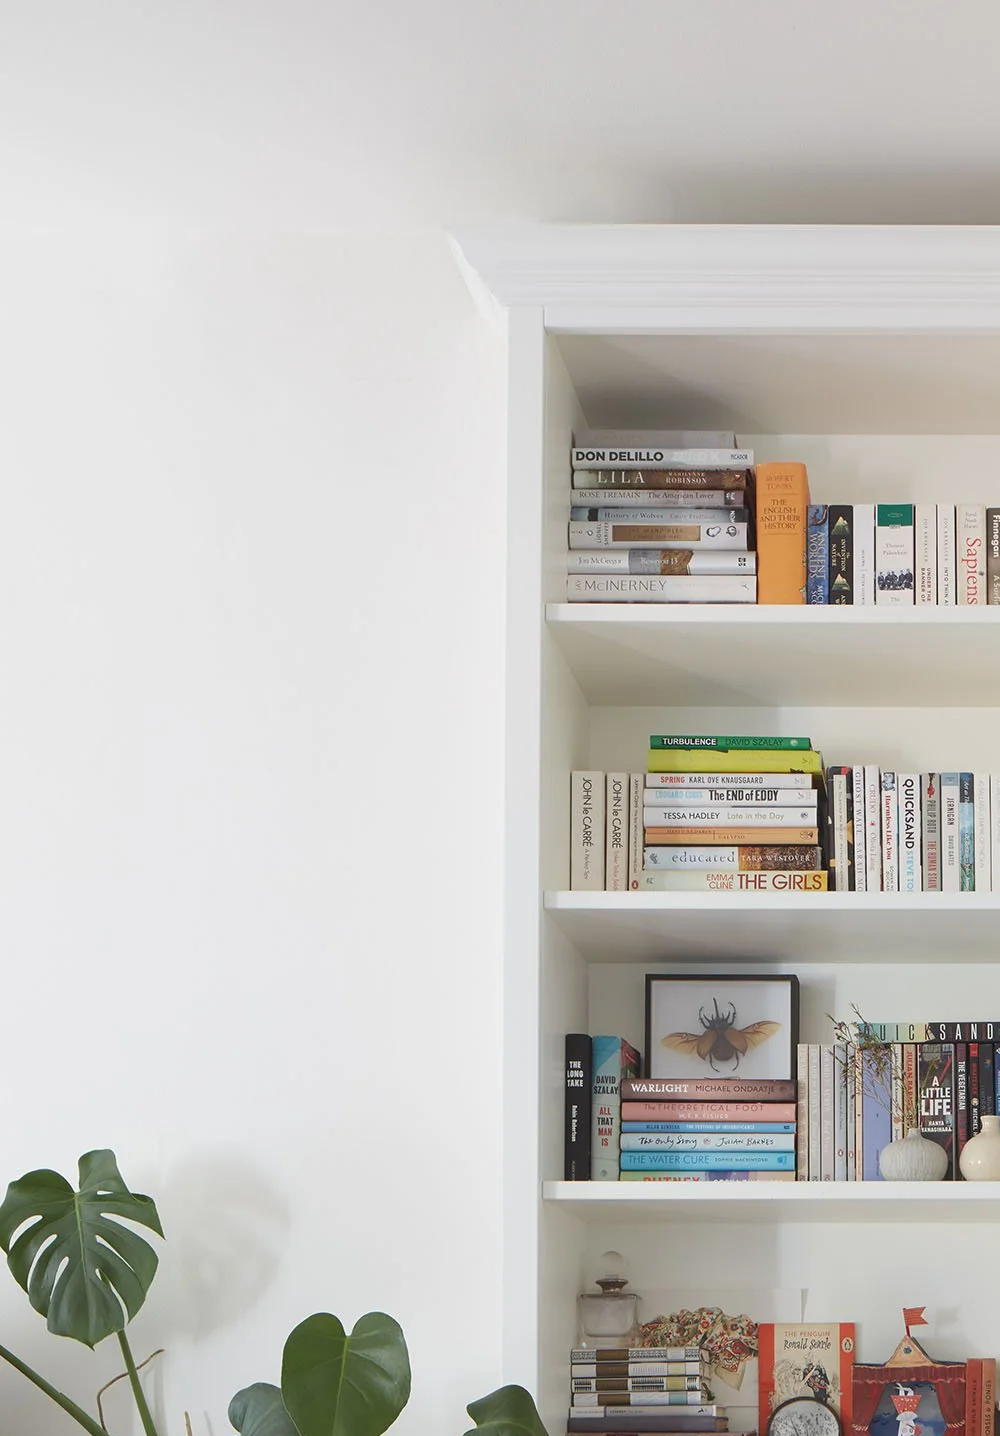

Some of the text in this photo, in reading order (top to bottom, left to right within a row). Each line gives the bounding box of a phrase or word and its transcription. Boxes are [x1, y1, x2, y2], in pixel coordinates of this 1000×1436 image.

[576, 452, 664, 462] DON DELILLO
[598, 471, 646, 484] LILA
[604, 512, 629, 520] History
[992, 514, 1000, 558] Finnegan
[809, 533, 818, 578] WORLDS
[818, 532, 826, 580] ANCIENT
[962, 538, 982, 605] Sapiens
[584, 580, 667, 592] McINERNEY
[920, 594, 926, 602] OF
[662, 738, 717, 746] TURBULENCE
[726, 738, 784, 746] DAVID SZALAY
[660, 776, 685, 784] SPRING
[688, 776, 764, 784] KARL OVE KNAUSGAARD
[708, 790, 779, 802] The END of EDDY
[582, 778, 594, 846] JOHN le CARRÉ
[612, 779, 623, 848] JOHN le CARRÉ
[664, 812, 720, 820] TESSA HADLEY
[769, 812, 784, 821] Day
[902, 778, 914, 849] QUICKSAND
[946, 797, 955, 826] JERNIGAN
[671, 851, 736, 862] educated
[928, 840, 937, 888] THE HUMAN STAIN
[709, 882, 734, 890] CLINE
[736, 874, 822, 890] THE GIRLS
[568, 1060, 582, 1068] THE
[566, 1070, 584, 1078] LONG
[567, 1079, 584, 1088] TAKE
[596, 1076, 616, 1084] DAVID
[932, 1076, 940, 1086] A
[958, 1060, 966, 1110] THE VEGETARIAN
[594, 1086, 619, 1094] SZALAY
[630, 1083, 688, 1093] WARLIGHT
[733, 1086, 774, 1094] ONDAATJE
[921, 1087, 951, 1098] LITTLE
[599, 1107, 612, 1116] ALL
[921, 1098, 952, 1116] LIFE
[597, 1117, 614, 1126] THAT
[598, 1128, 613, 1136] MAN
[601, 1138, 609, 1146] IS
[676, 1137, 697, 1148] Story
[628, 1155, 710, 1164] THE WATER CURE
[784, 1339, 832, 1351] Ronald Searle
